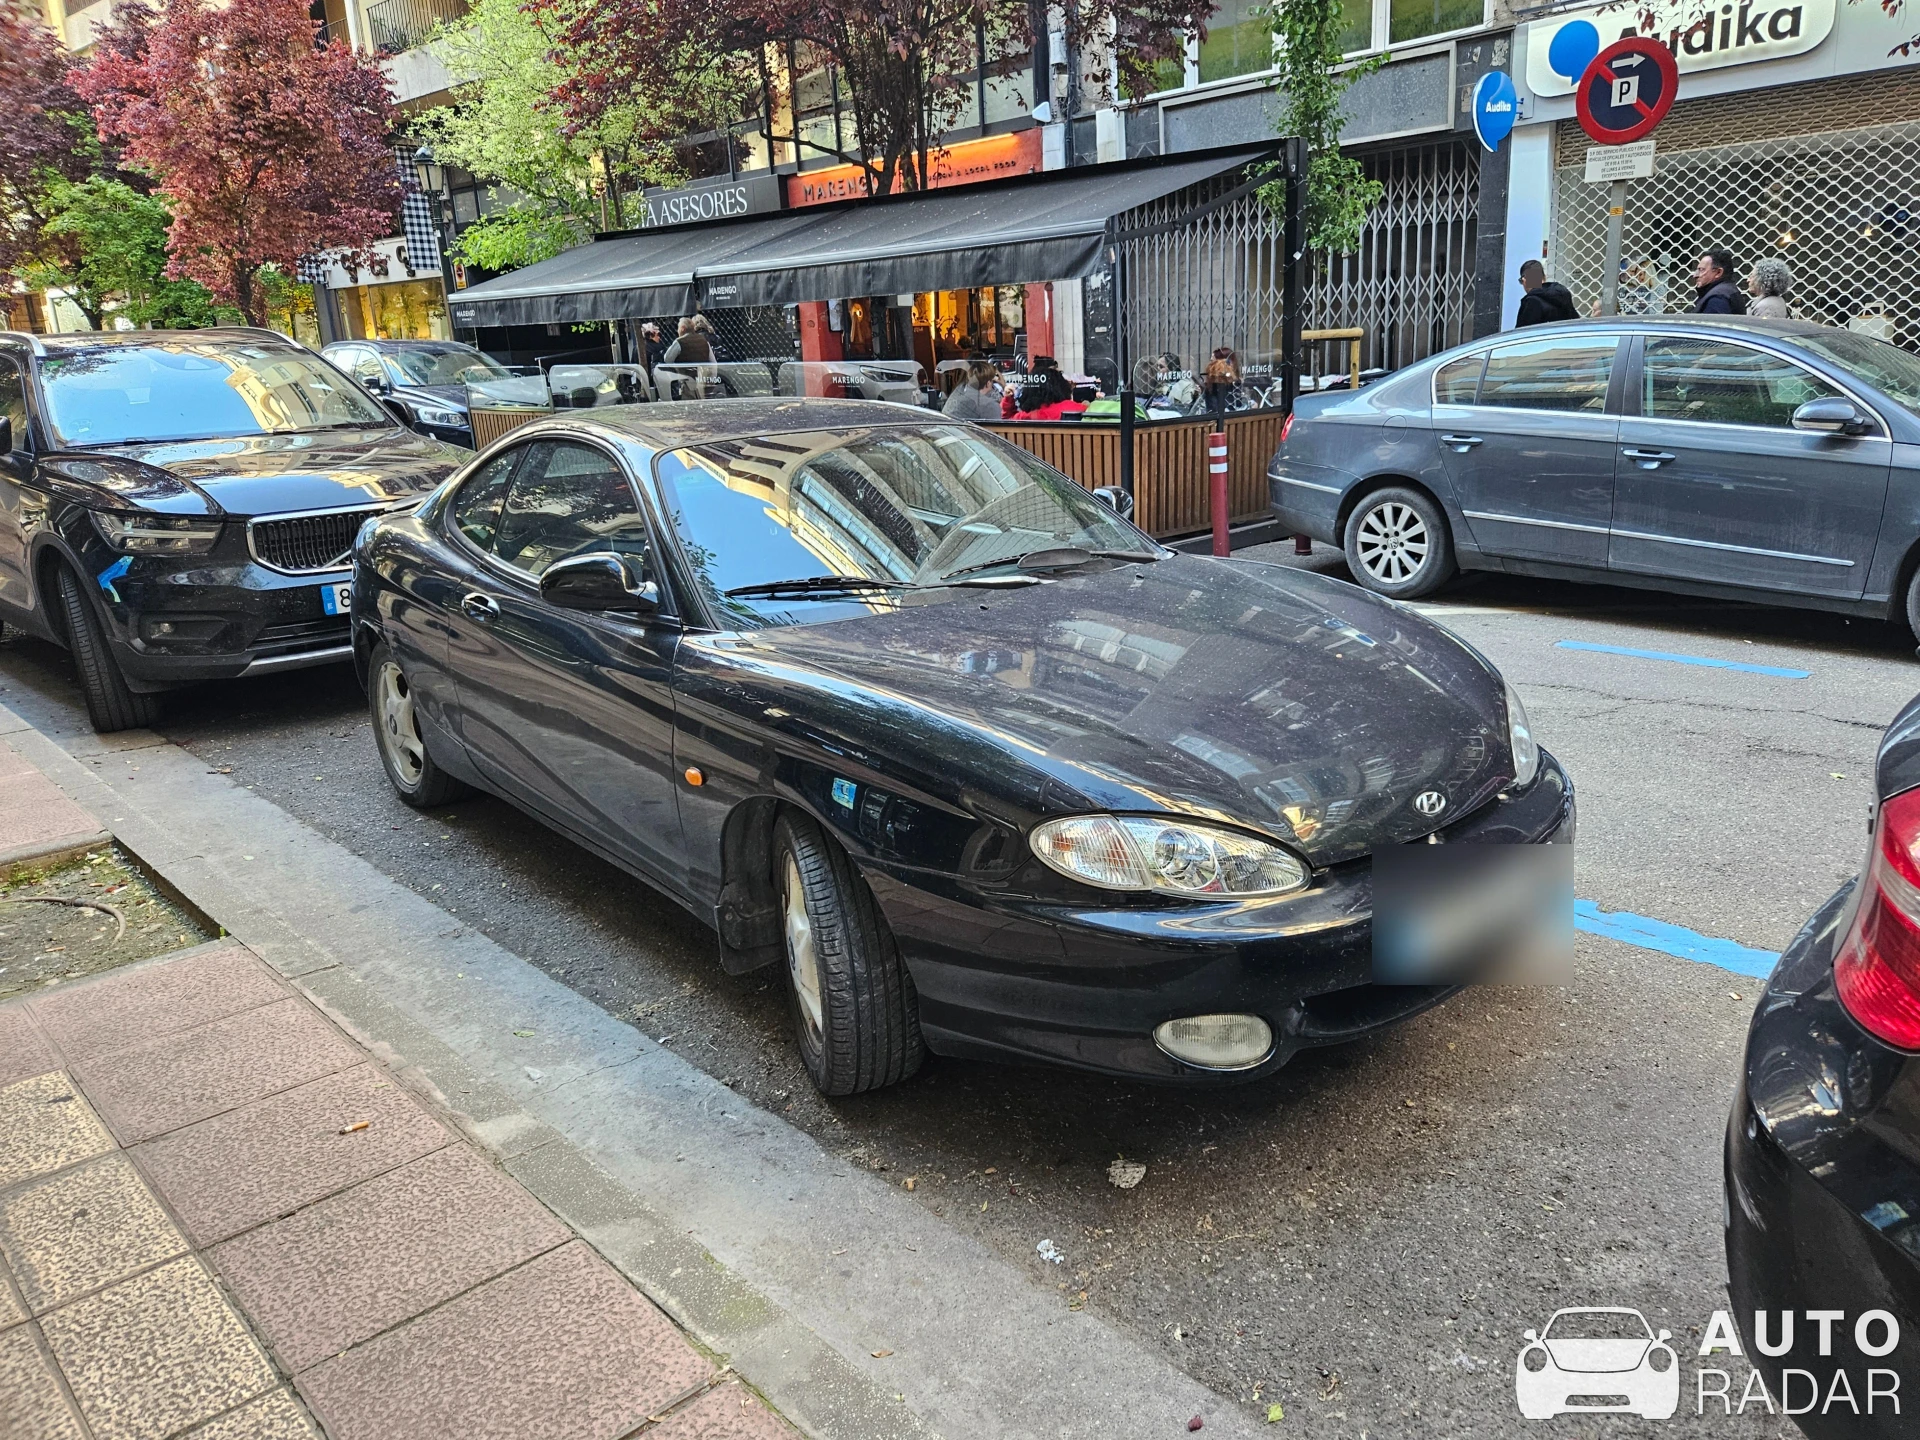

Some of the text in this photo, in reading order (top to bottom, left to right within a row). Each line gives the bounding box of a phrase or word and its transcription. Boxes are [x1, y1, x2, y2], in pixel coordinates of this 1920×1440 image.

[1618, 80, 1631, 104] P
[1485, 100, 1512, 113] Audika
[965, 165, 990, 175] LOCAL
[994, 160, 1016, 170] FOOD
[803, 173, 878, 201] MARENG
[660, 186, 748, 225] ASESORES
[708, 285, 737, 296] MARENGO
[456, 309, 476, 318] MARENGO
[1156, 369, 1192, 381] MARENGO
[1241, 364, 1273, 376] MARENGO
[832, 376, 866, 385] MARENGO
